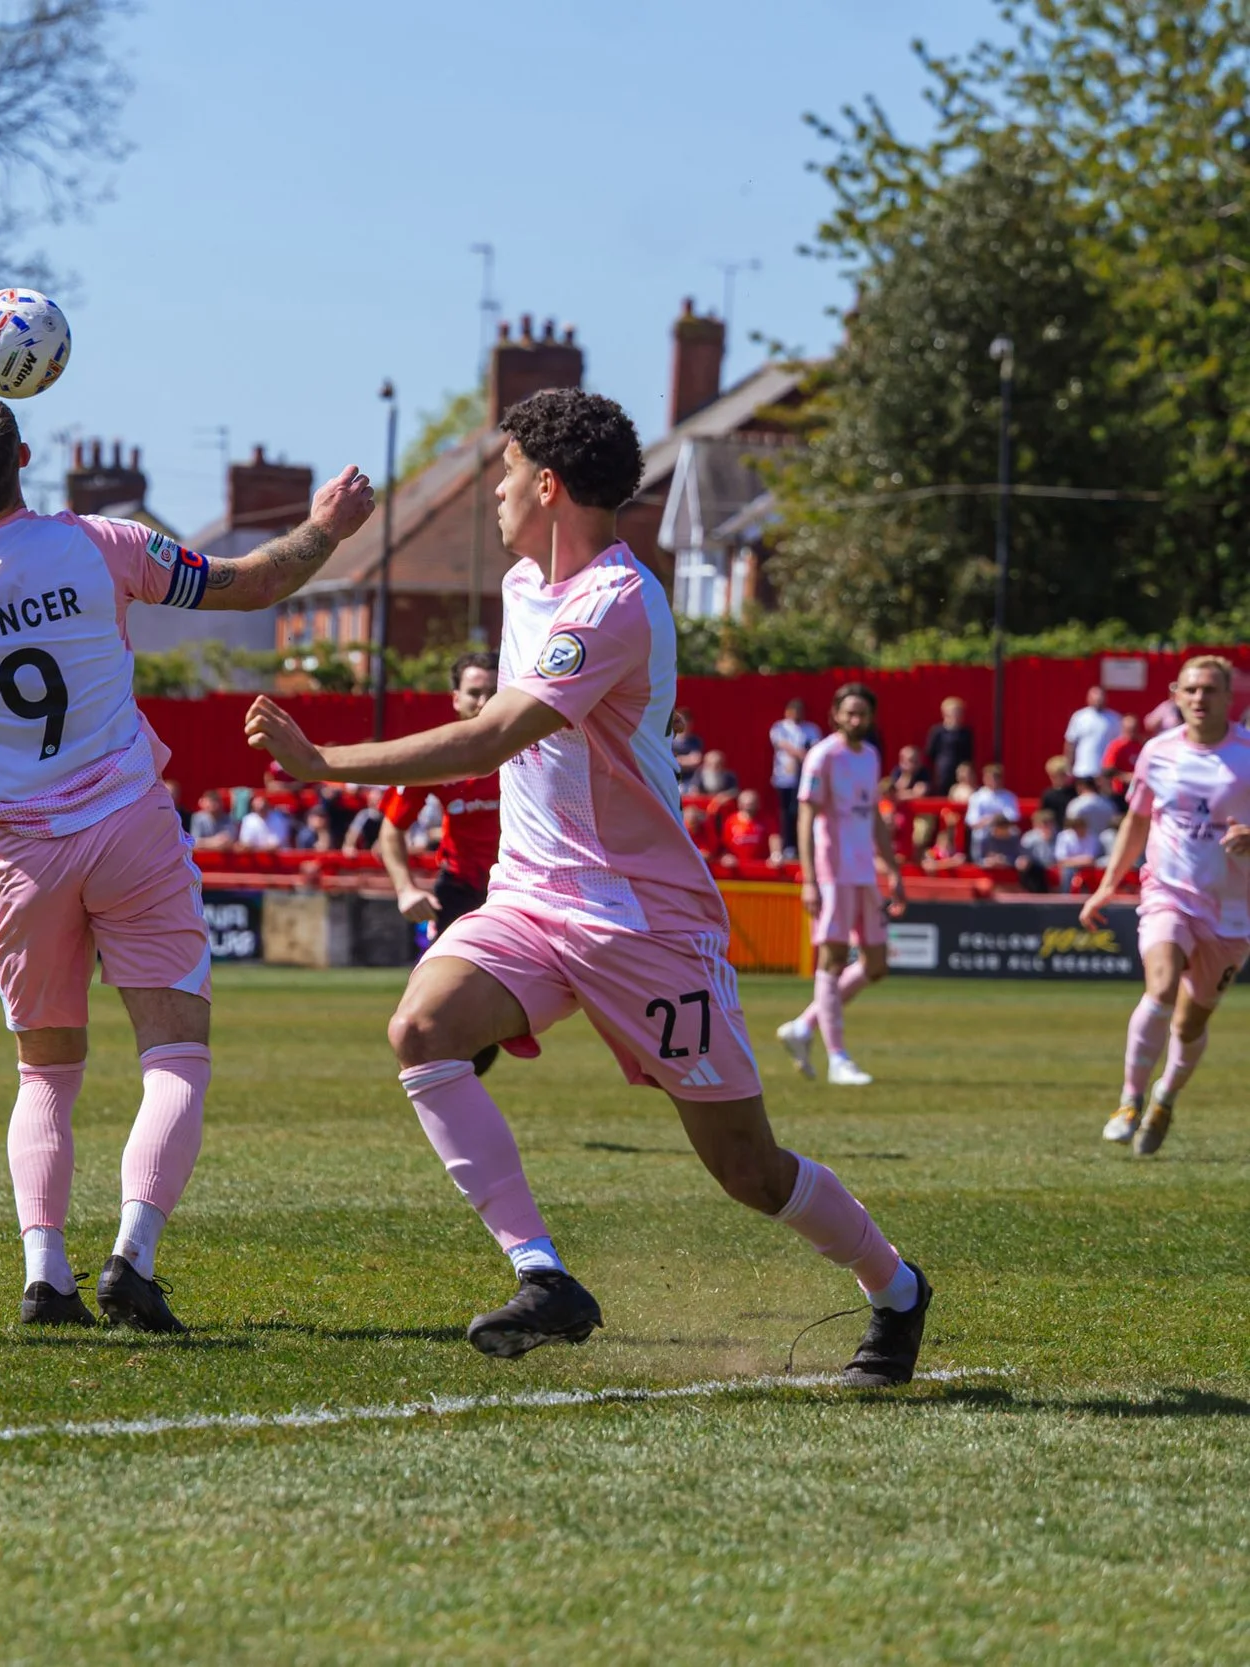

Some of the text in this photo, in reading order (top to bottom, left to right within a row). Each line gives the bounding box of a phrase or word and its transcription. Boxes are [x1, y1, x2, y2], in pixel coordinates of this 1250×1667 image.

[12, 349, 38, 388] Mitre
[958, 931, 1040, 950] FOLLOW
[948, 951, 1132, 974] CLUB ALL SEASON
[645, 988, 710, 1060] 27
